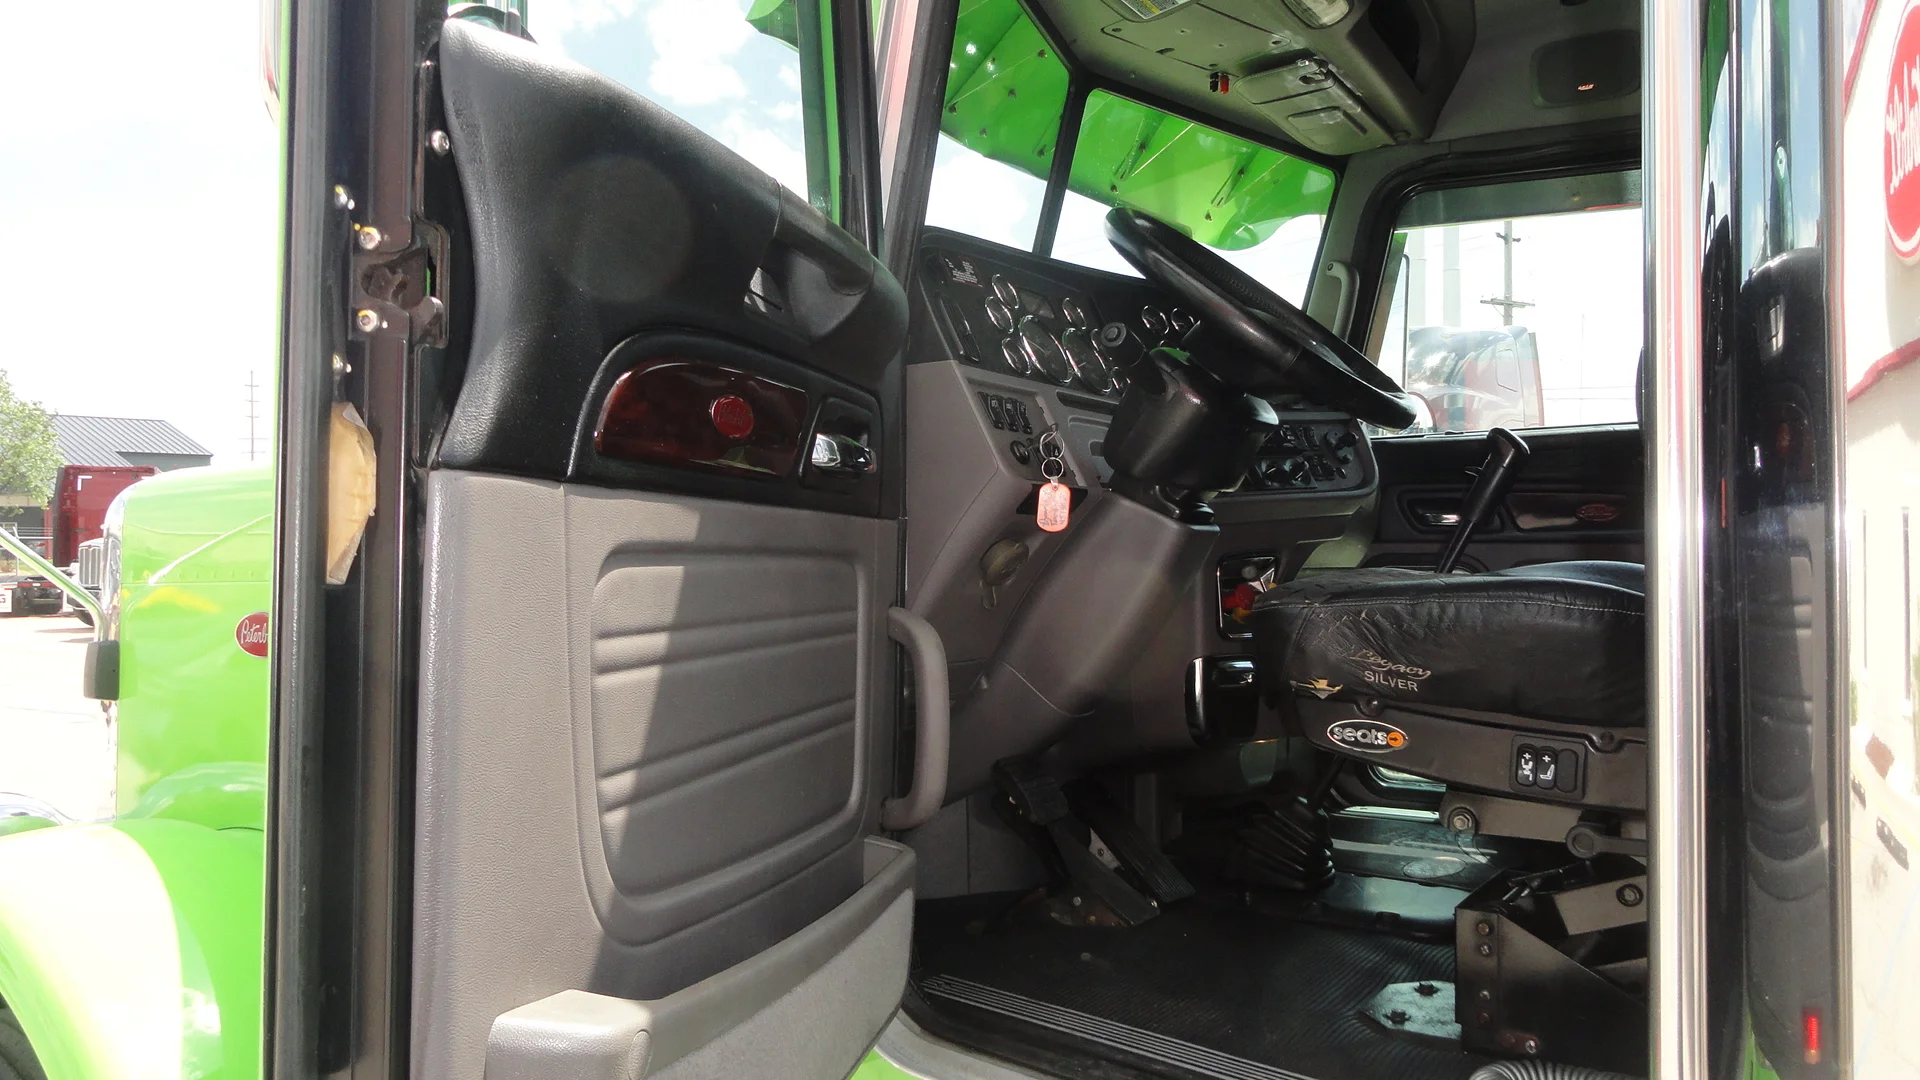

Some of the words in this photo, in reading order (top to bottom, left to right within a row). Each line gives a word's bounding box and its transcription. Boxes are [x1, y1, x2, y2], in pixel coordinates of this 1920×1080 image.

[240, 619, 269, 645] Peterb
[1349, 648, 1432, 680] Legacy
[1364, 670, 1419, 692] SILVER
[1332, 726, 1387, 745] seats
